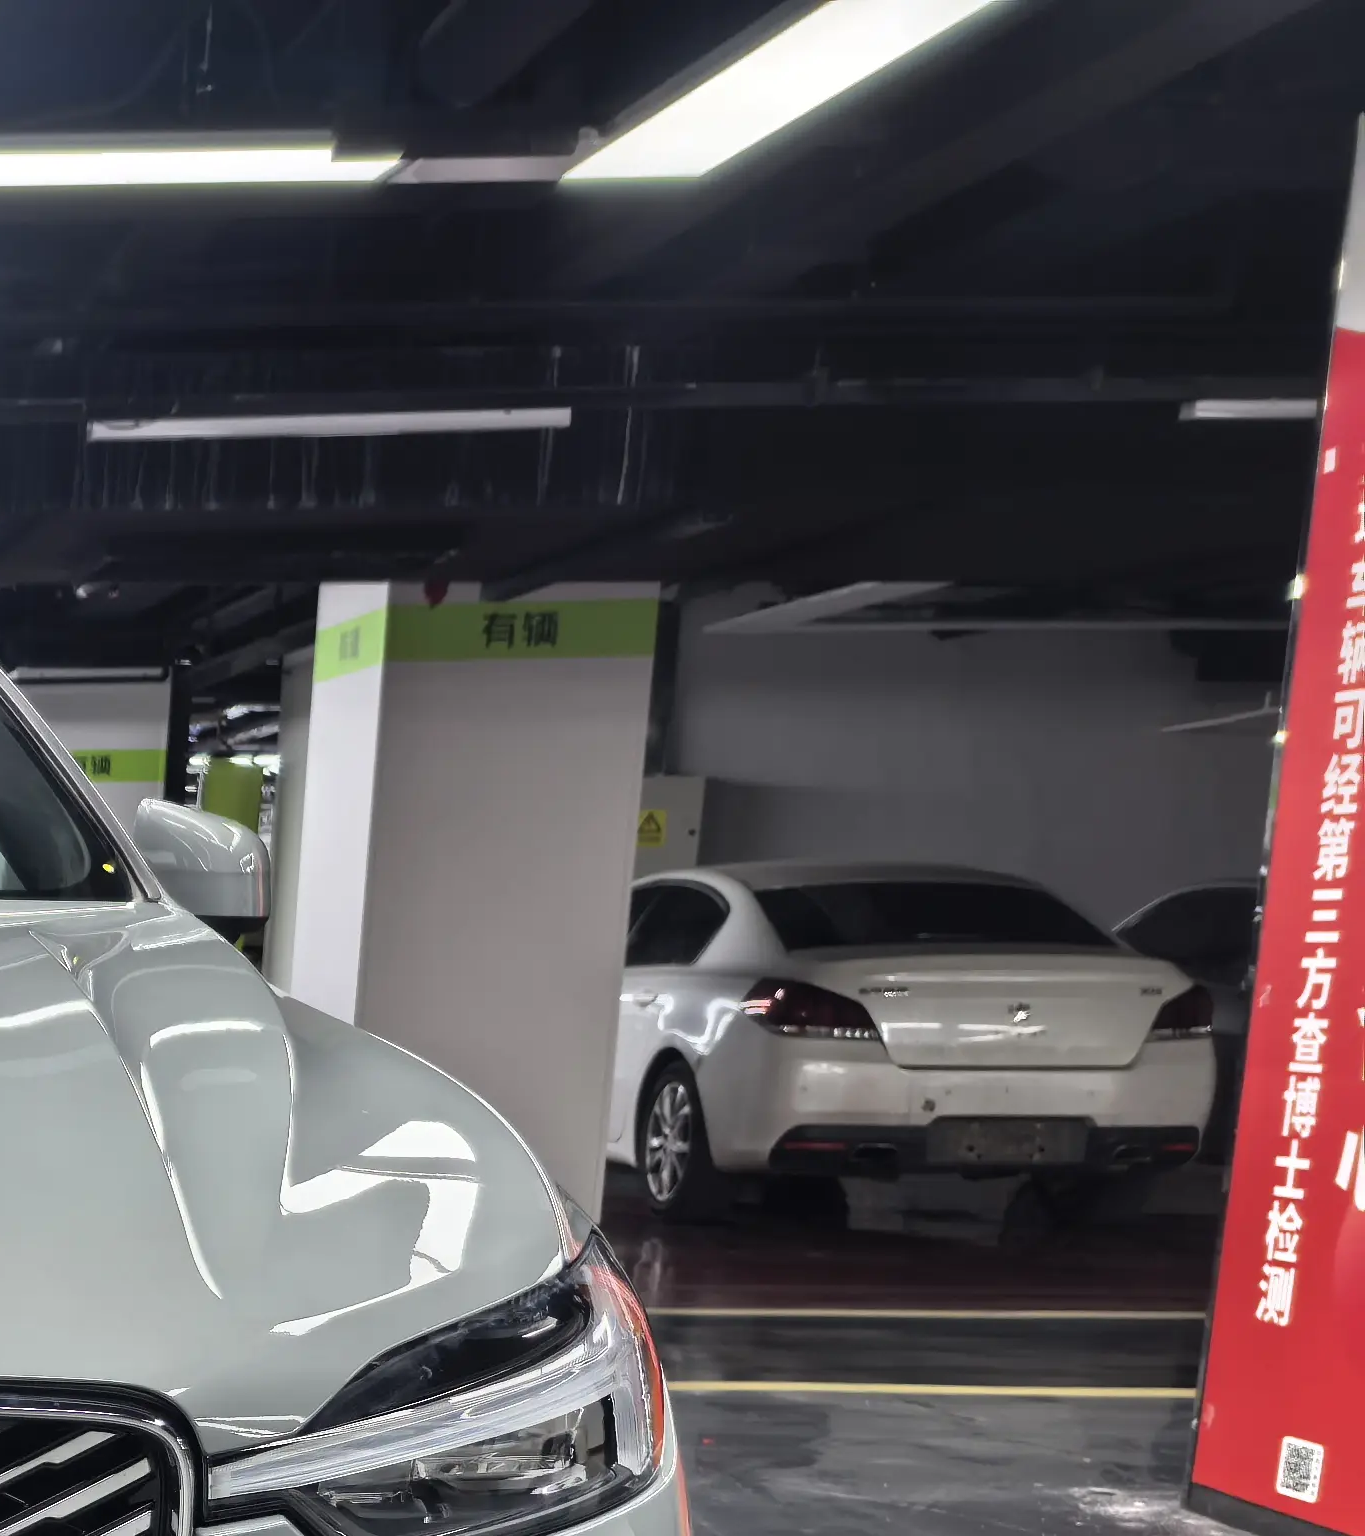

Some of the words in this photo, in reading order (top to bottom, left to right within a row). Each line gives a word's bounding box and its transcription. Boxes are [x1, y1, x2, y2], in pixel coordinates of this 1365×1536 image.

[1254, 502, 1365, 1327] 车辆可经第三方查博士检测
